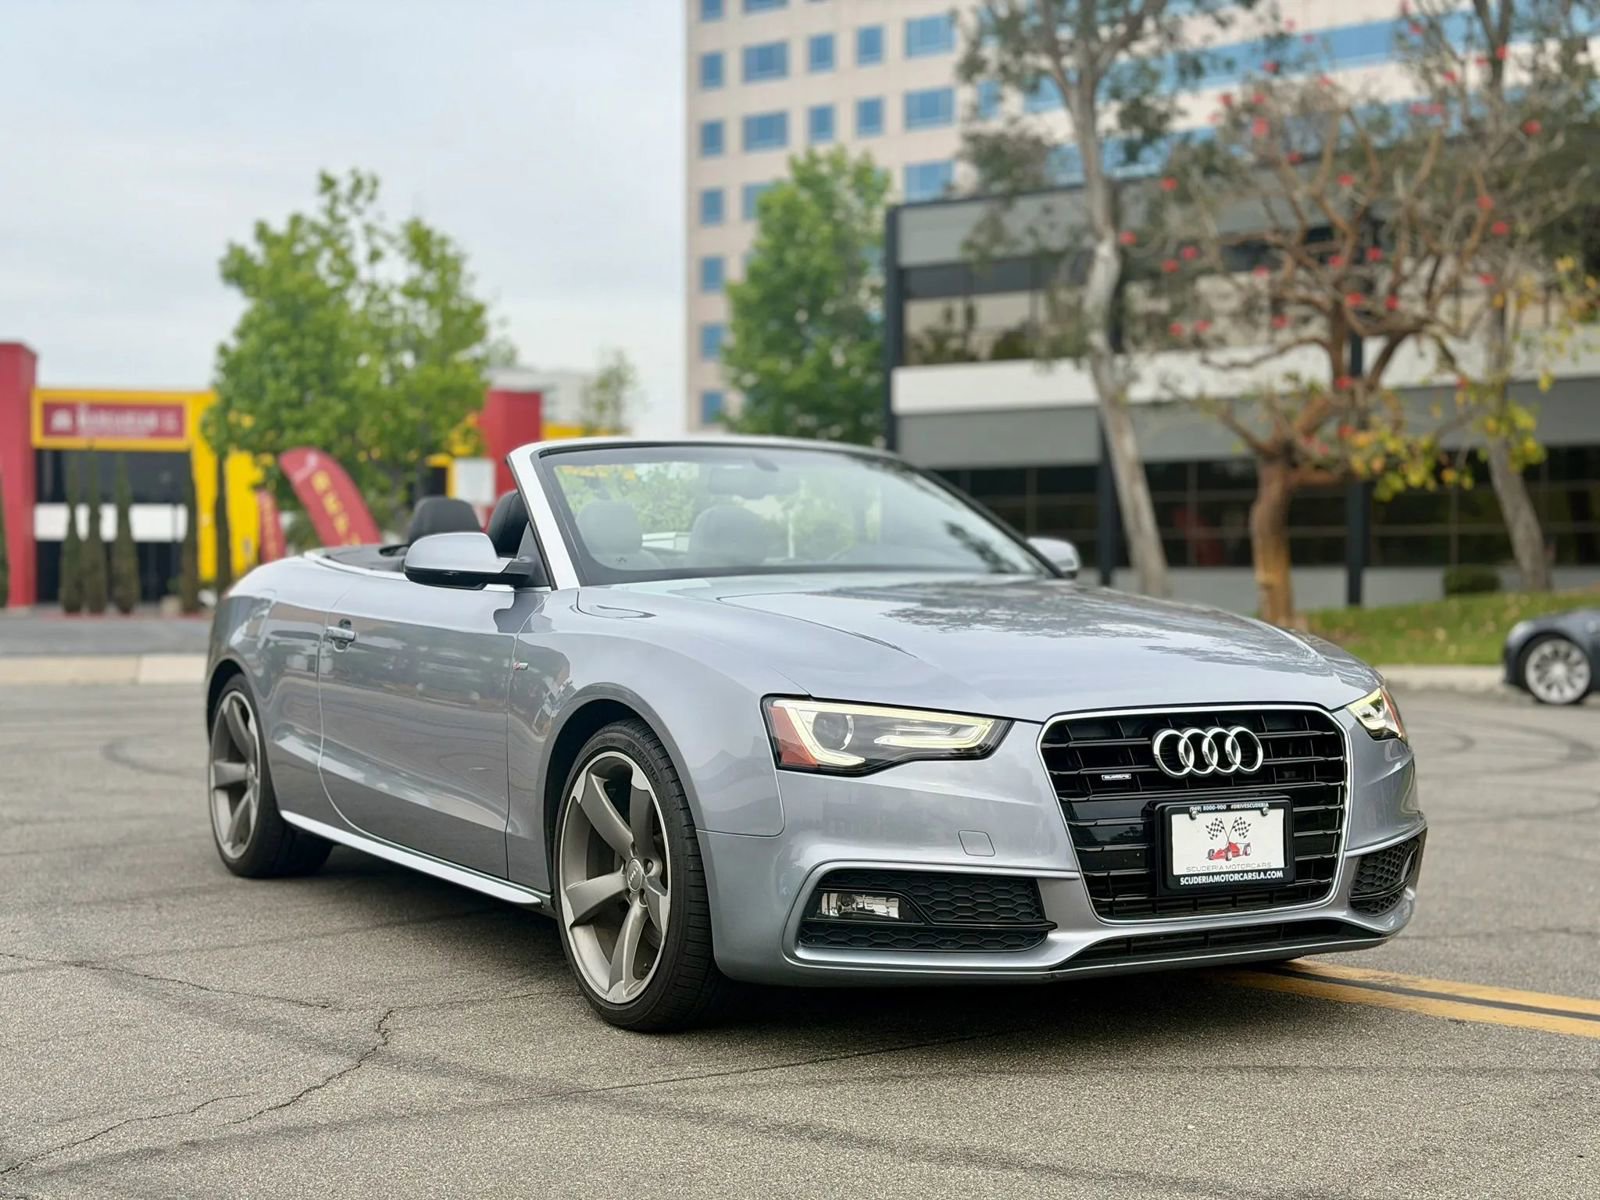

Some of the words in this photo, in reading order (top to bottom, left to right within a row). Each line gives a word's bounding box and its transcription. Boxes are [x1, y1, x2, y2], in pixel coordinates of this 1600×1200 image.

[1186, 865, 1224, 873] SCUDERIA
[1225, 862, 1272, 870] MOTORCARS
[1180, 870, 1284, 885] SCUDERIAMOTORCARSLA.COM
